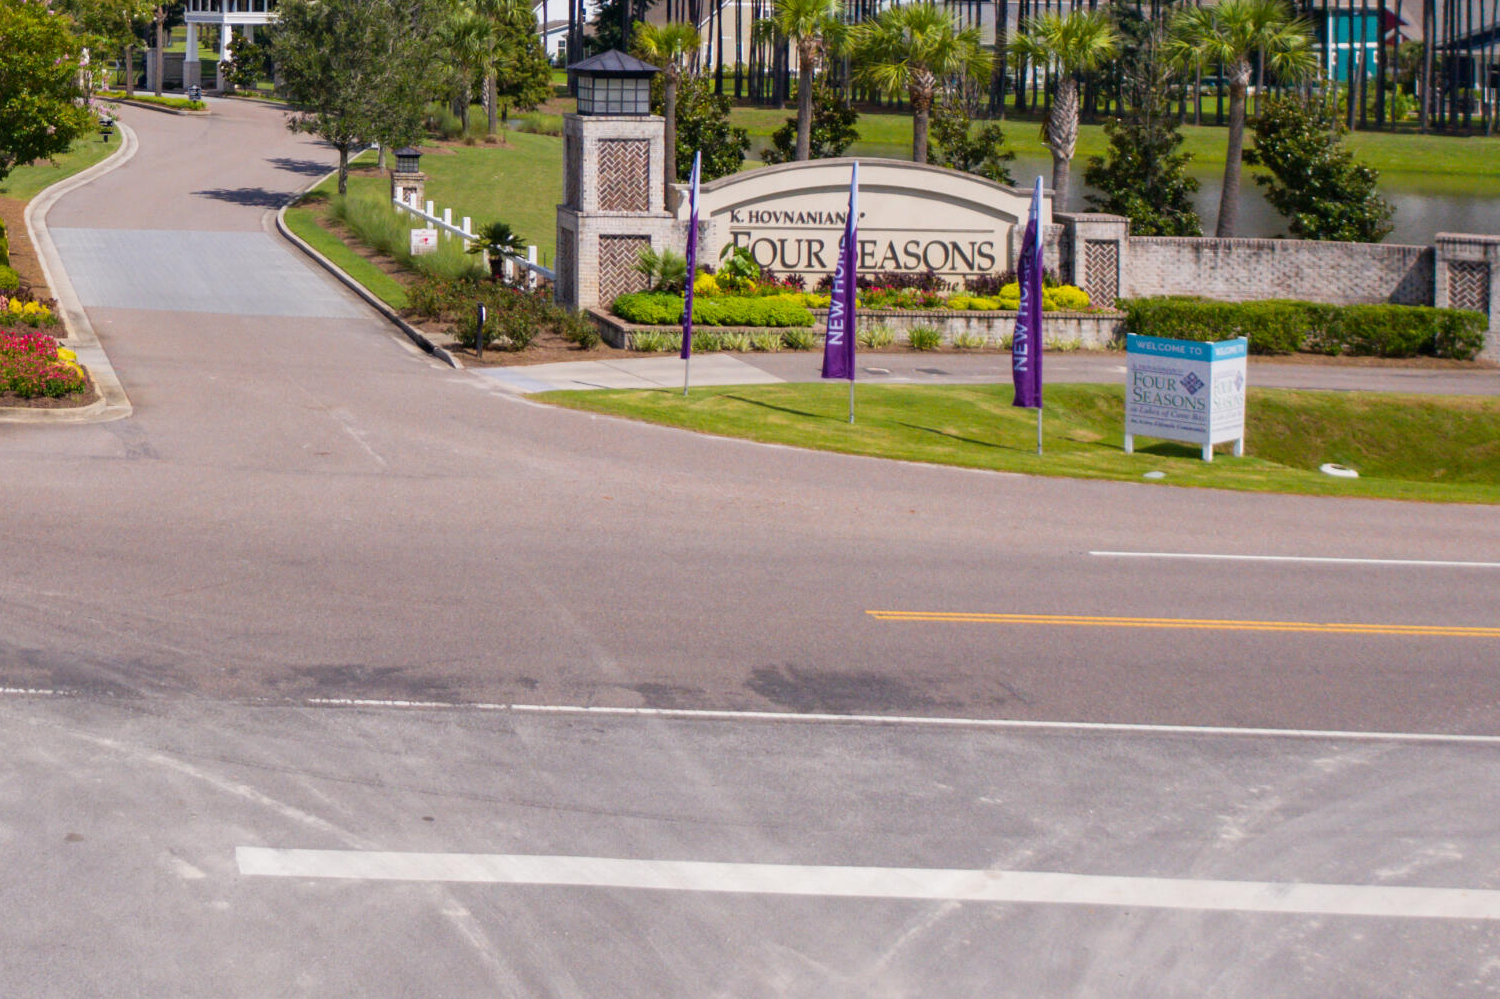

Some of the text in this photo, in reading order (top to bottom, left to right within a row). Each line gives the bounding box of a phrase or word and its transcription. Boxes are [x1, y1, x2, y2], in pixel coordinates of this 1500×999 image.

[730, 211, 744, 223] K.
[839, 235, 996, 271] EASONS
[828, 299, 844, 345] NEW
[1013, 323, 1028, 371] NEW
[1135, 339, 1186, 354] WELCOME
[1190, 346, 1203, 355] TO
[1133, 371, 1177, 392] FOUR
[1132, 387, 1206, 411] SEASONS
